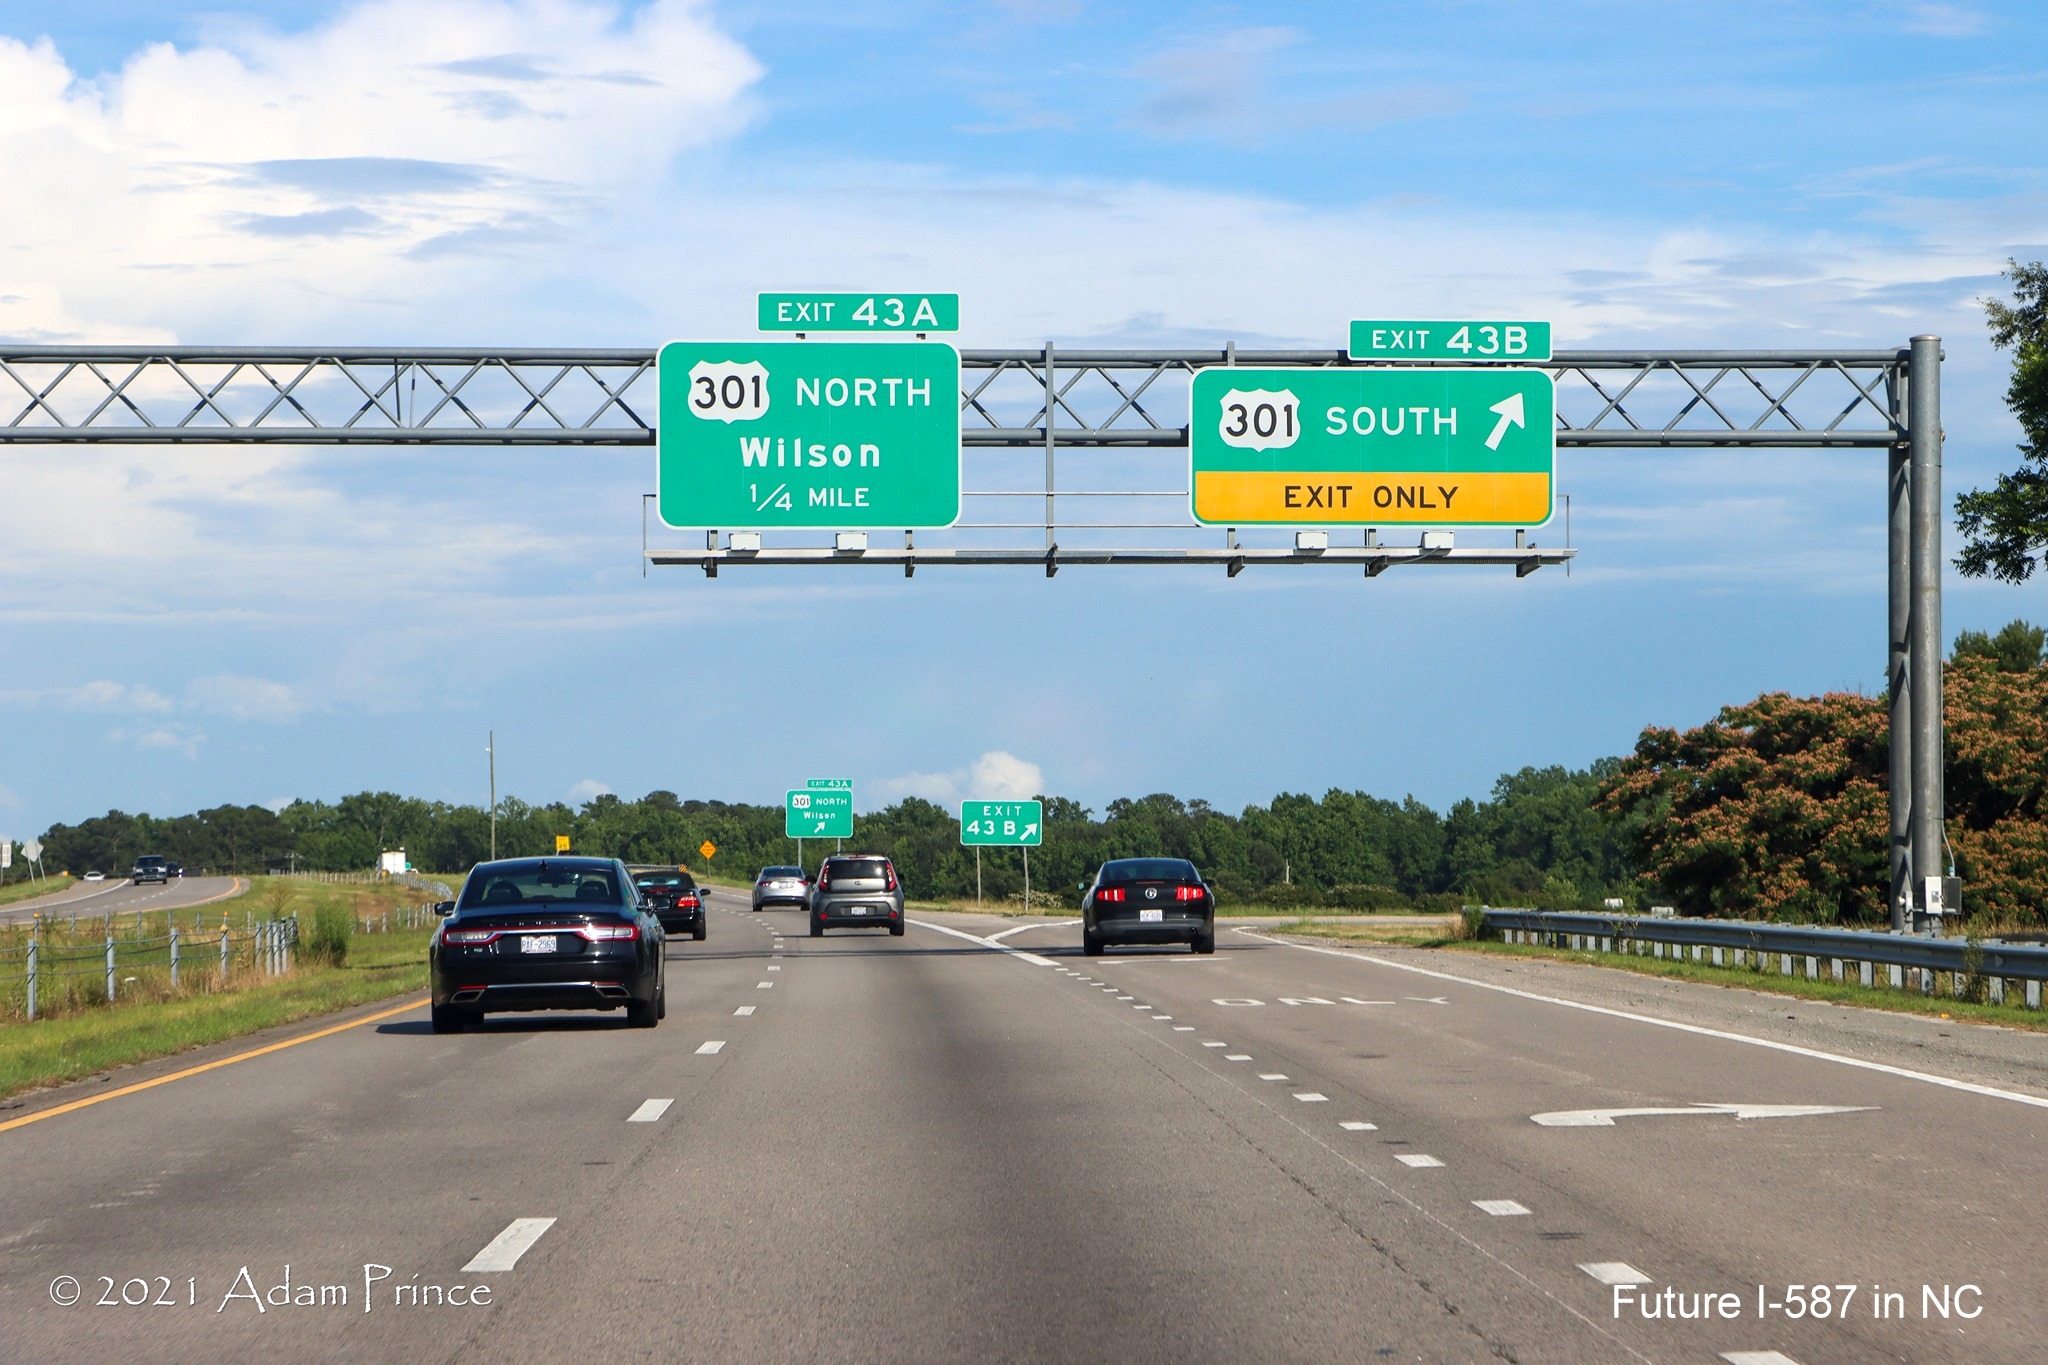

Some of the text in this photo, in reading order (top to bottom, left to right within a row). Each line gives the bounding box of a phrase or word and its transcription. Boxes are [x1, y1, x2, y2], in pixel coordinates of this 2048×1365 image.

[778, 298, 939, 327] EXIT 43A
[1372, 326, 1528, 354] EXIT 43B
[694, 374, 931, 409] 301 NORTH
[1225, 403, 1457, 437] 301 SOUTH
[739, 437, 880, 468] Wilson
[749, 484, 870, 511] 1/4 MILE
[1285, 485, 1460, 508] EXIT ONLY
[828, 780, 848, 788] 43A
[794, 797, 848, 806] 301 NORTH
[983, 805, 1022, 816] EXIT
[803, 811, 836, 820] Wilson
[1211, 996, 1451, 1007] ONLY
